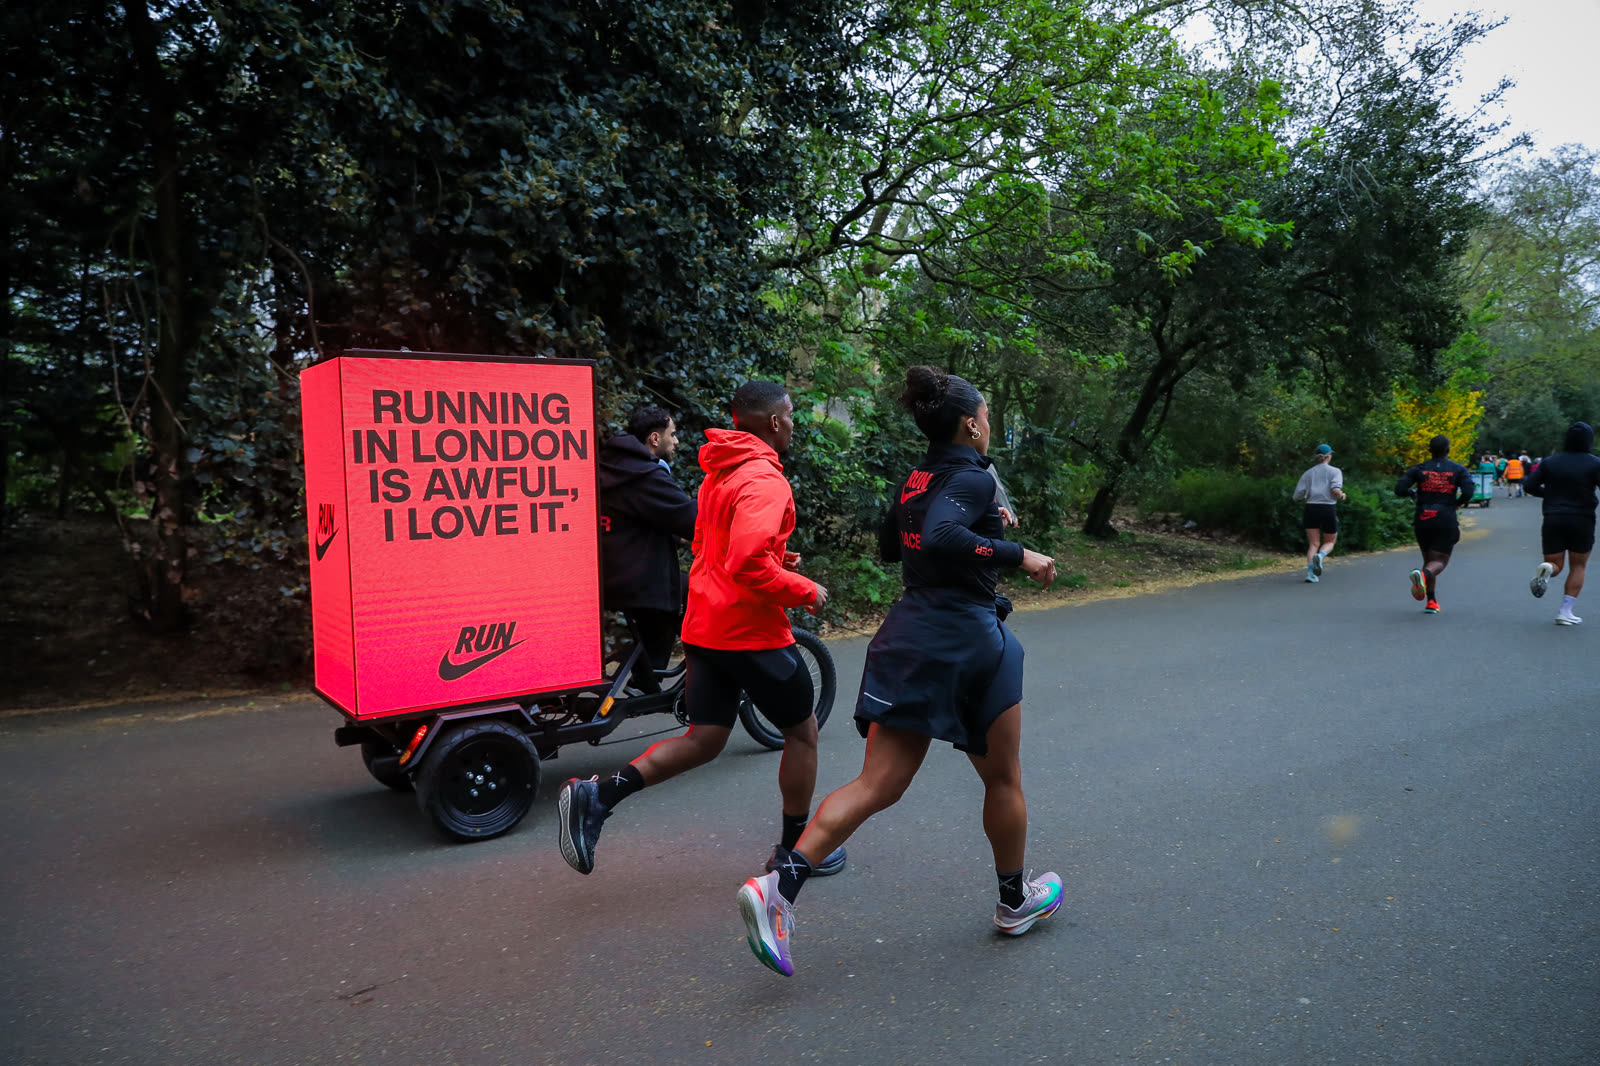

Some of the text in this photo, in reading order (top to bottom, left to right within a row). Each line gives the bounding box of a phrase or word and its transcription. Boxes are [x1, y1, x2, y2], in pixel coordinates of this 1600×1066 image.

[372, 389, 571, 424] RUNNING
[352, 428, 588, 464] IN LONDON
[369, 465, 579, 504] IS AWFUL,
[905, 470, 934, 490] RUN
[318, 502, 336, 536] RUN
[384, 502, 570, 542] I LOVE IT.
[454, 621, 518, 655] RUN
